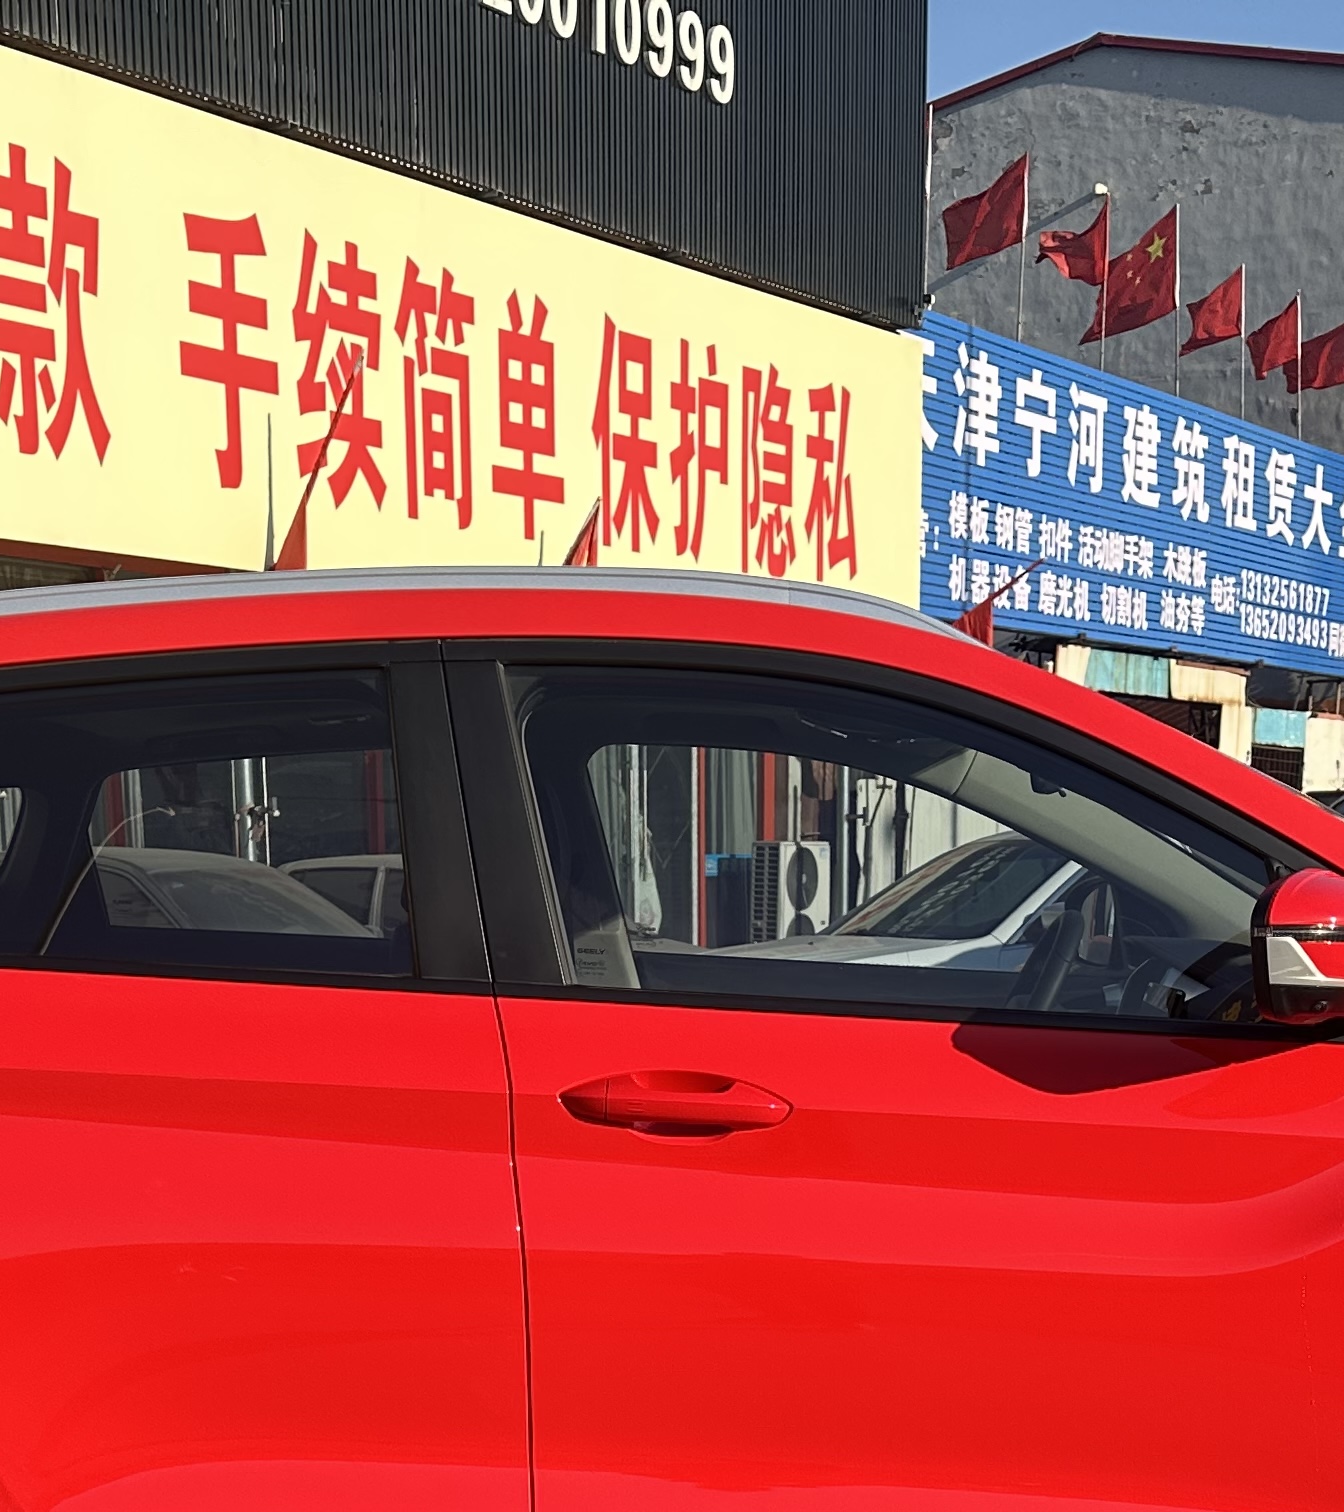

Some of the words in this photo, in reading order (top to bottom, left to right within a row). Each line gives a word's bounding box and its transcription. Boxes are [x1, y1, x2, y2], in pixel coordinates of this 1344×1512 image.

[179, 212, 566, 541] 手续简单
[591, 311, 858, 582] 保护隐私
[948, 489, 990, 545] 模板
[994, 502, 1034, 555] 钢管
[1038, 513, 1074, 564] 扣件
[948, 553, 1032, 612] 机器设备
[1037, 569, 1091, 622] 磨光机
[1100, 582, 1149, 631] 切割机
[1240, 568, 1330, 617] 13132561877
